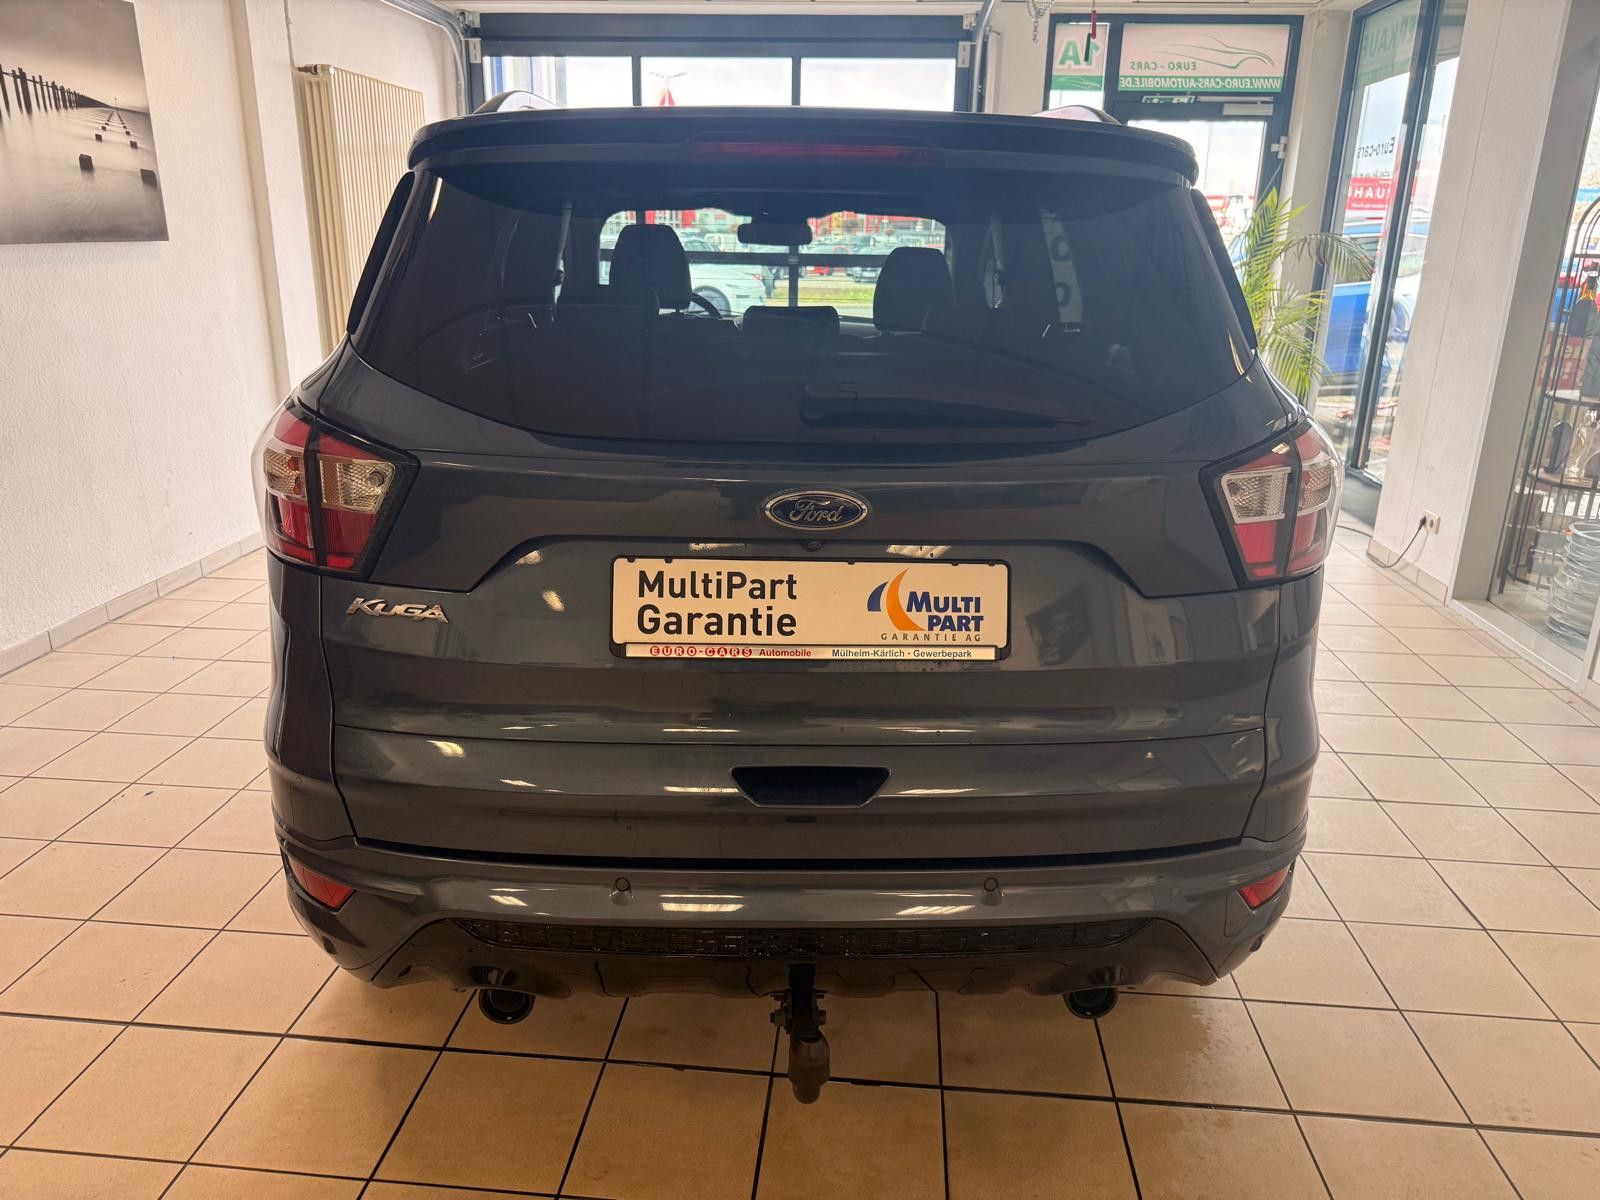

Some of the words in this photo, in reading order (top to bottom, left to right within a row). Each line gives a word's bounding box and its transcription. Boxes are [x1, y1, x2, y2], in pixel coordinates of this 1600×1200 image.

[789, 499, 844, 522] Ford
[638, 570, 797, 600] MultiPart
[345, 597, 449, 624] KUGA
[906, 591, 981, 613] MULTI
[637, 603, 797, 636] Garantie
[927, 615, 984, 632] PART
[880, 633, 957, 641] GARANTIE
[965, 633, 981, 642] AG
[759, 648, 812, 657] Automobile
[832, 649, 905, 658] Mülheim-Kärlich
[913, 650, 972, 660] Gewerbepark
